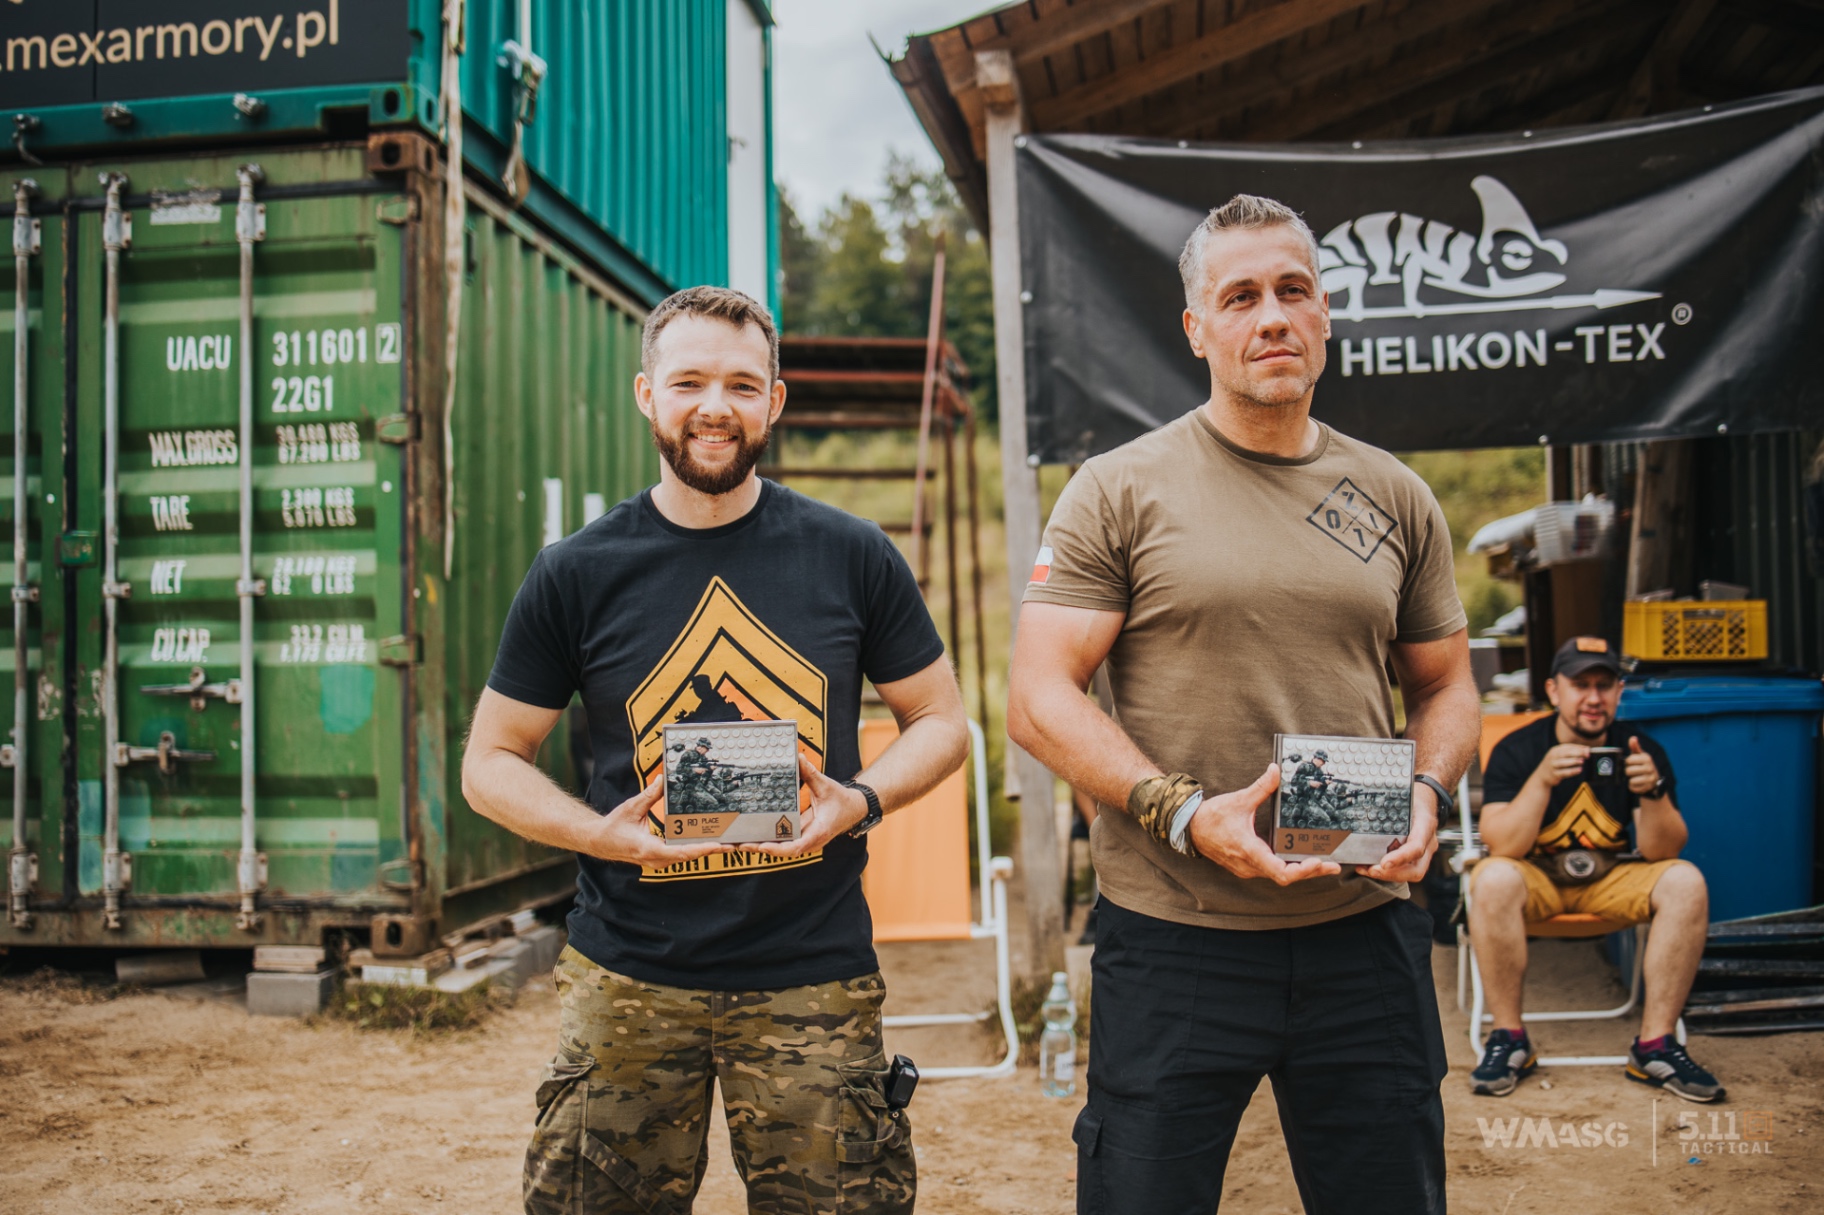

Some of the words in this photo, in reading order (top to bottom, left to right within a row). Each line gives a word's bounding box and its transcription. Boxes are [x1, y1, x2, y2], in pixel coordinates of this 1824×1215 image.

[0, 0, 340, 72] mexarmory.pl
[166, 334, 232, 371] UACU
[272, 326, 367, 367] 311601
[380, 325, 397, 362] 2
[1340, 322, 1667, 377] HELIKON-TEX
[271, 375, 333, 412] 22G1
[150, 495, 194, 531] TARE
[150, 560, 187, 594] NET
[673, 819, 684, 835] 3
[687, 818, 698, 827] RD
[1284, 833, 1294, 850] 3
